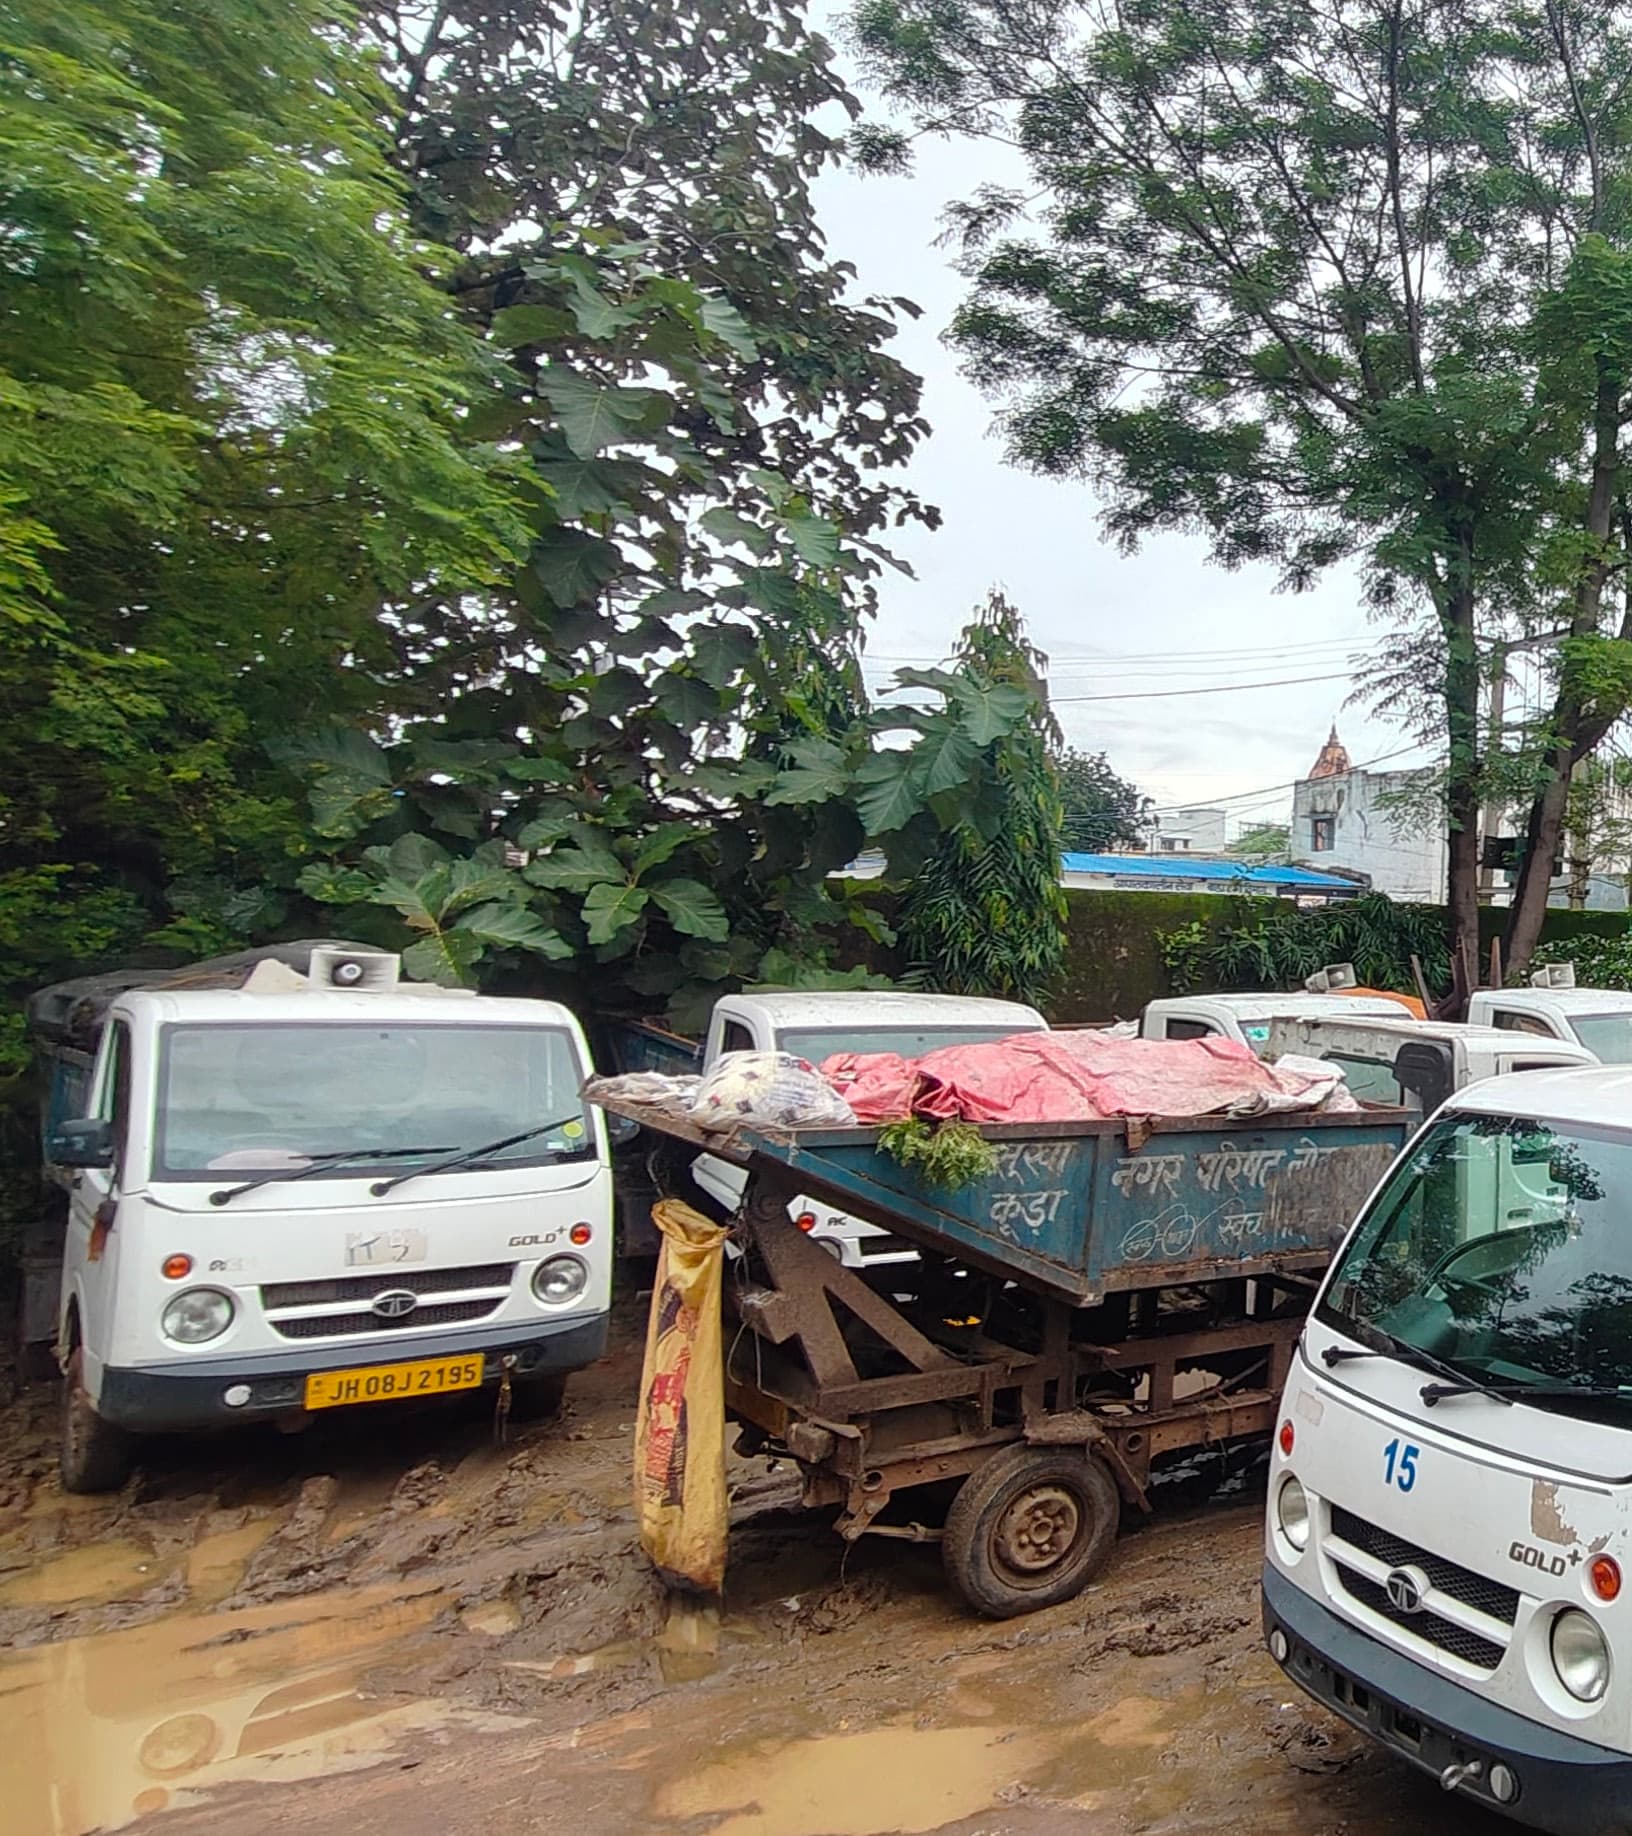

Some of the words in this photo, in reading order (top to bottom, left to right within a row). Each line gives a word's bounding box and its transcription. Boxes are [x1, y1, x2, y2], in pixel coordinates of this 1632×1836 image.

[1111, 1154, 1185, 1199] नगर
[990, 1189, 1070, 1241] कूड़ा
[1383, 1438, 1420, 1492] 15
